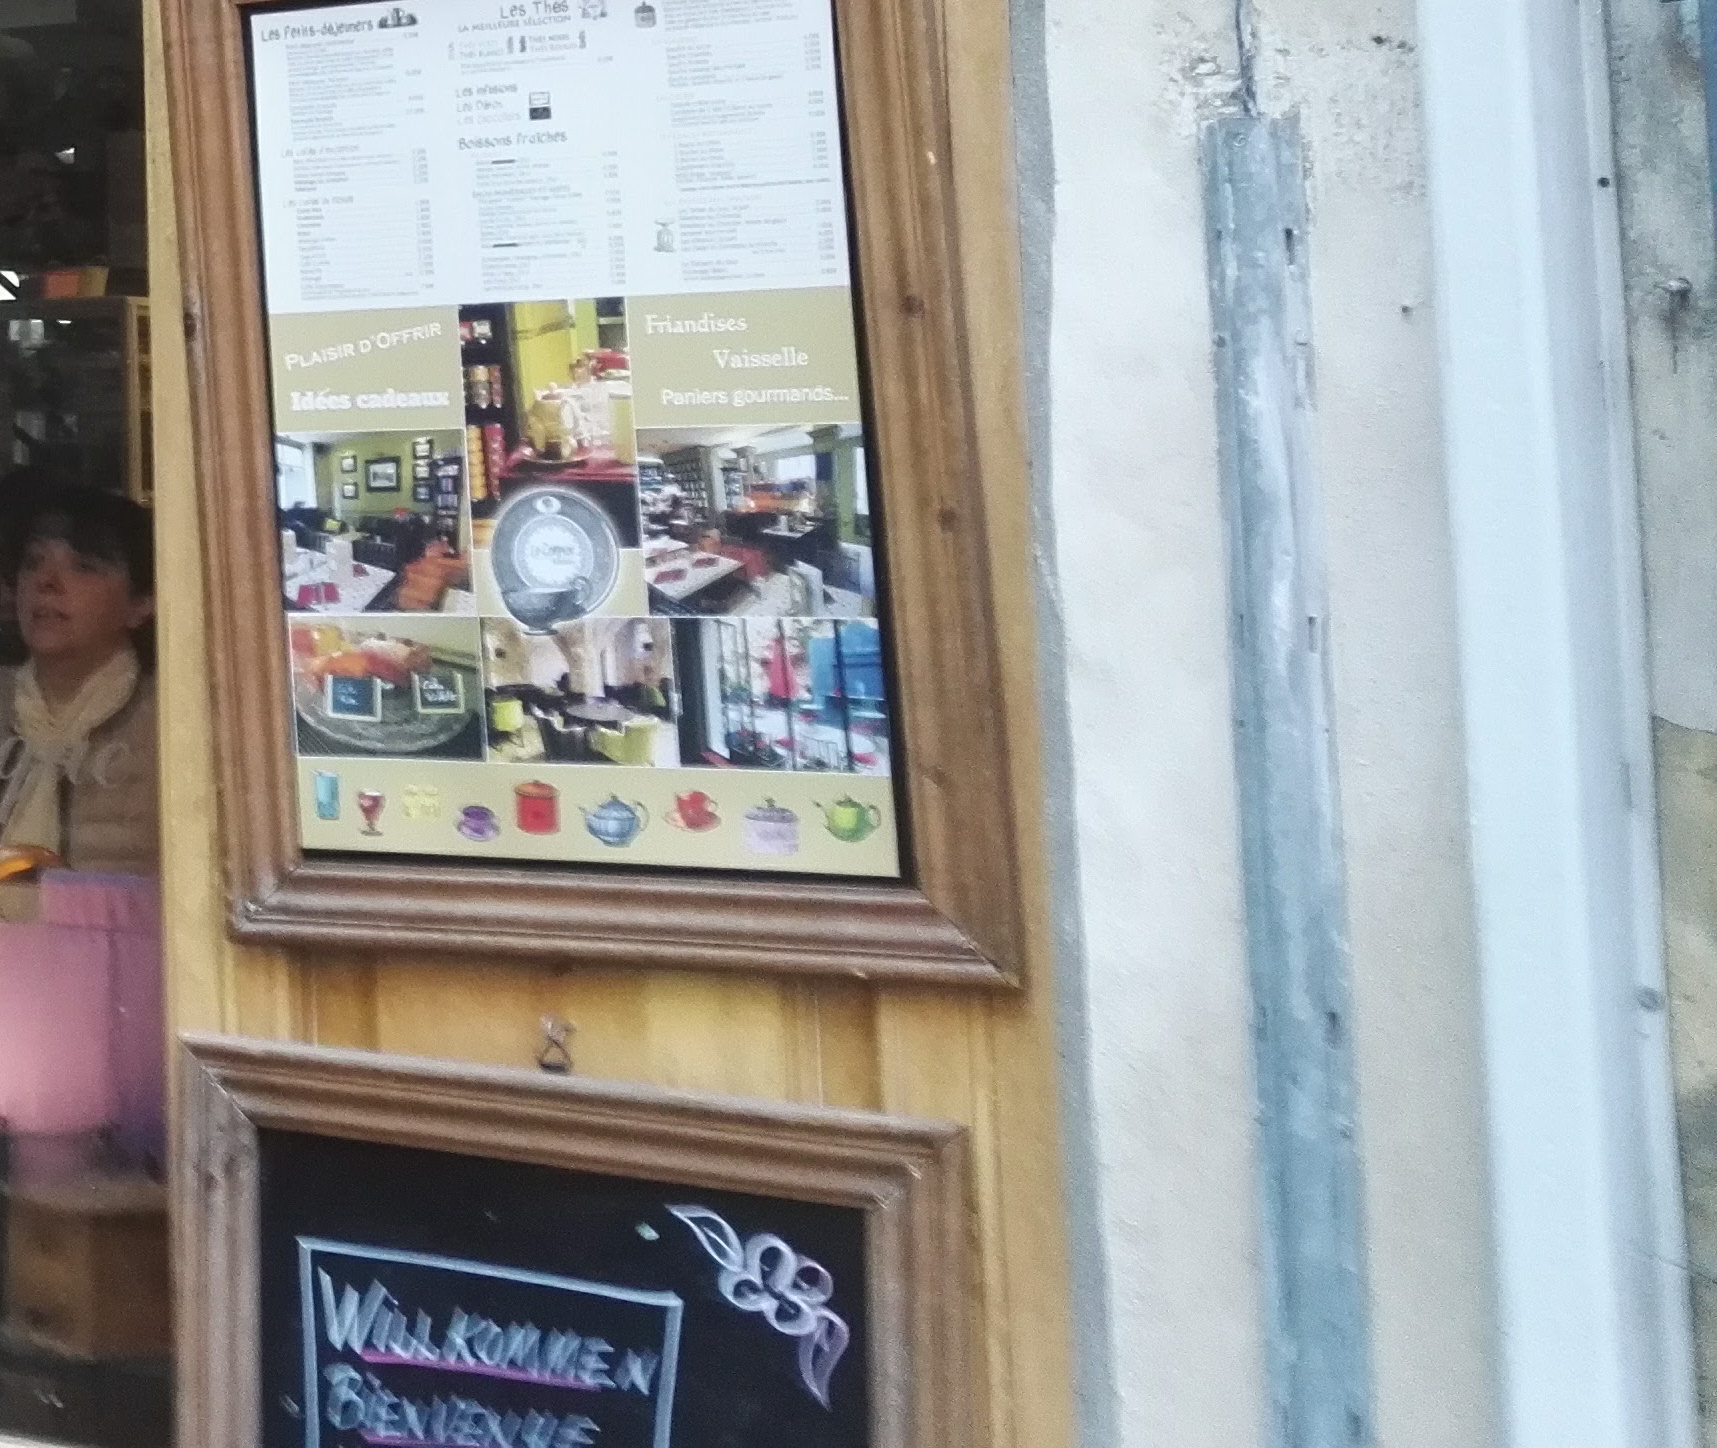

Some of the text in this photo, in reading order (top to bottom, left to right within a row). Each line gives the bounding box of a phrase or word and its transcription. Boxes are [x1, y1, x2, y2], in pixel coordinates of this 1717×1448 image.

[499, 3, 527, 19] Les
[645, 312, 748, 336] Friandises
[283, 344, 356, 372] PLAISIR
[713, 348, 809, 370] Vaisselle
[290, 388, 450, 412] Idées cadeaux
[661, 387, 728, 407] Paniers
